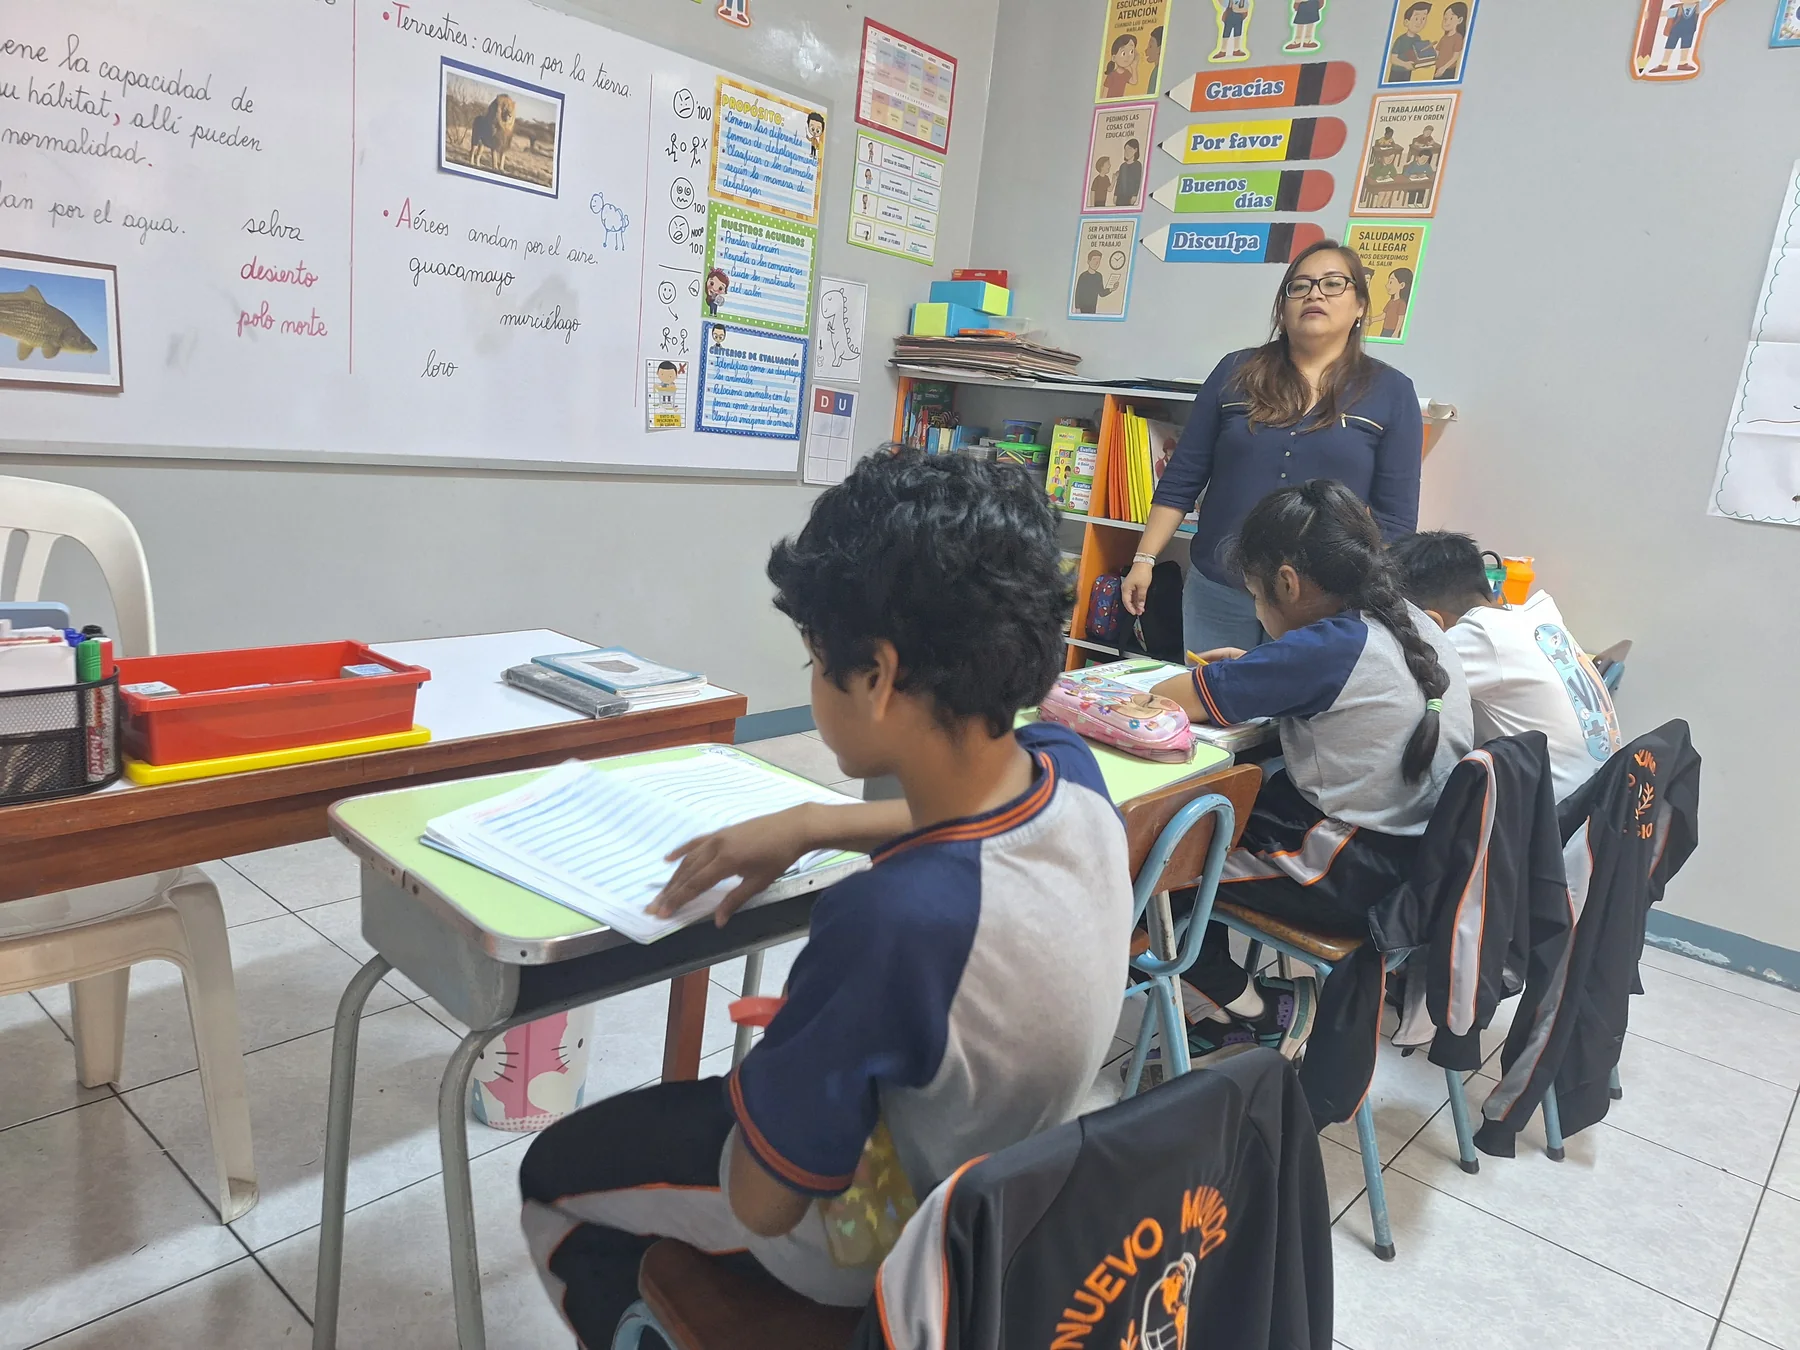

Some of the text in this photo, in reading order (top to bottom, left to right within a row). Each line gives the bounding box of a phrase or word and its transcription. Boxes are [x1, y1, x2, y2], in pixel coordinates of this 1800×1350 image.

[1116, 0, 1147, 9] ESCUCHO
[0, 34, 254, 113] ene la capacidad de
[482, 35, 534, 66] andan
[539, 57, 564, 80] por
[572, 53, 586, 82] la
[593, 63, 632, 98] tierra.
[1205, 79, 1284, 100] Gracias
[28, 76, 120, 126] hábitat,
[130, 104, 183, 135] allí
[189, 125, 262, 151] pueden
[697, 105, 711, 121] 100
[722, 94, 785, 127] PROPÓSITO:
[1105, 113, 1140, 123] PEDIMOS LAS
[1380, 115, 1407, 123] SILENCIO
[1387, 104, 1446, 114] TRABAJAMOS EN
[1105, 130, 1135, 139] EDUCACIÓN
[1106, 123, 1123, 131] COSAS
[1190, 132, 1283, 151] Por favor
[1180, 178, 1247, 195] Buenos
[1234, 192, 1274, 210] días
[0, 181, 186, 244] an por el agua.
[241, 209, 304, 242] selva
[721, 219, 805, 248] NUESTROS ACUERDOS
[468, 225, 518, 251] andan
[524, 239, 546, 260] por
[548, 235, 562, 256] el
[567, 247, 599, 265] aire.
[1098, 240, 1122, 248] TRABAJO
[1171, 231, 1261, 254] Disculpa
[1358, 231, 1415, 242] SALUDAMOS
[1358, 242, 1407, 252] AL LLEGAR
[1372, 253, 1409, 261] DESPEDIMOS
[240, 255, 318, 288] desierto
[409, 257, 515, 297] guacamayo
[236, 300, 329, 338] polo norte
[500, 305, 582, 344] murciélago
[421, 349, 459, 378] loro
[708, 345, 800, 368] CRITERIOS DE EVALUACIÓN
[820, 395, 830, 408] D
[838, 398, 847, 411] U
[1050, 1217, 1164, 1350] NUEVO
